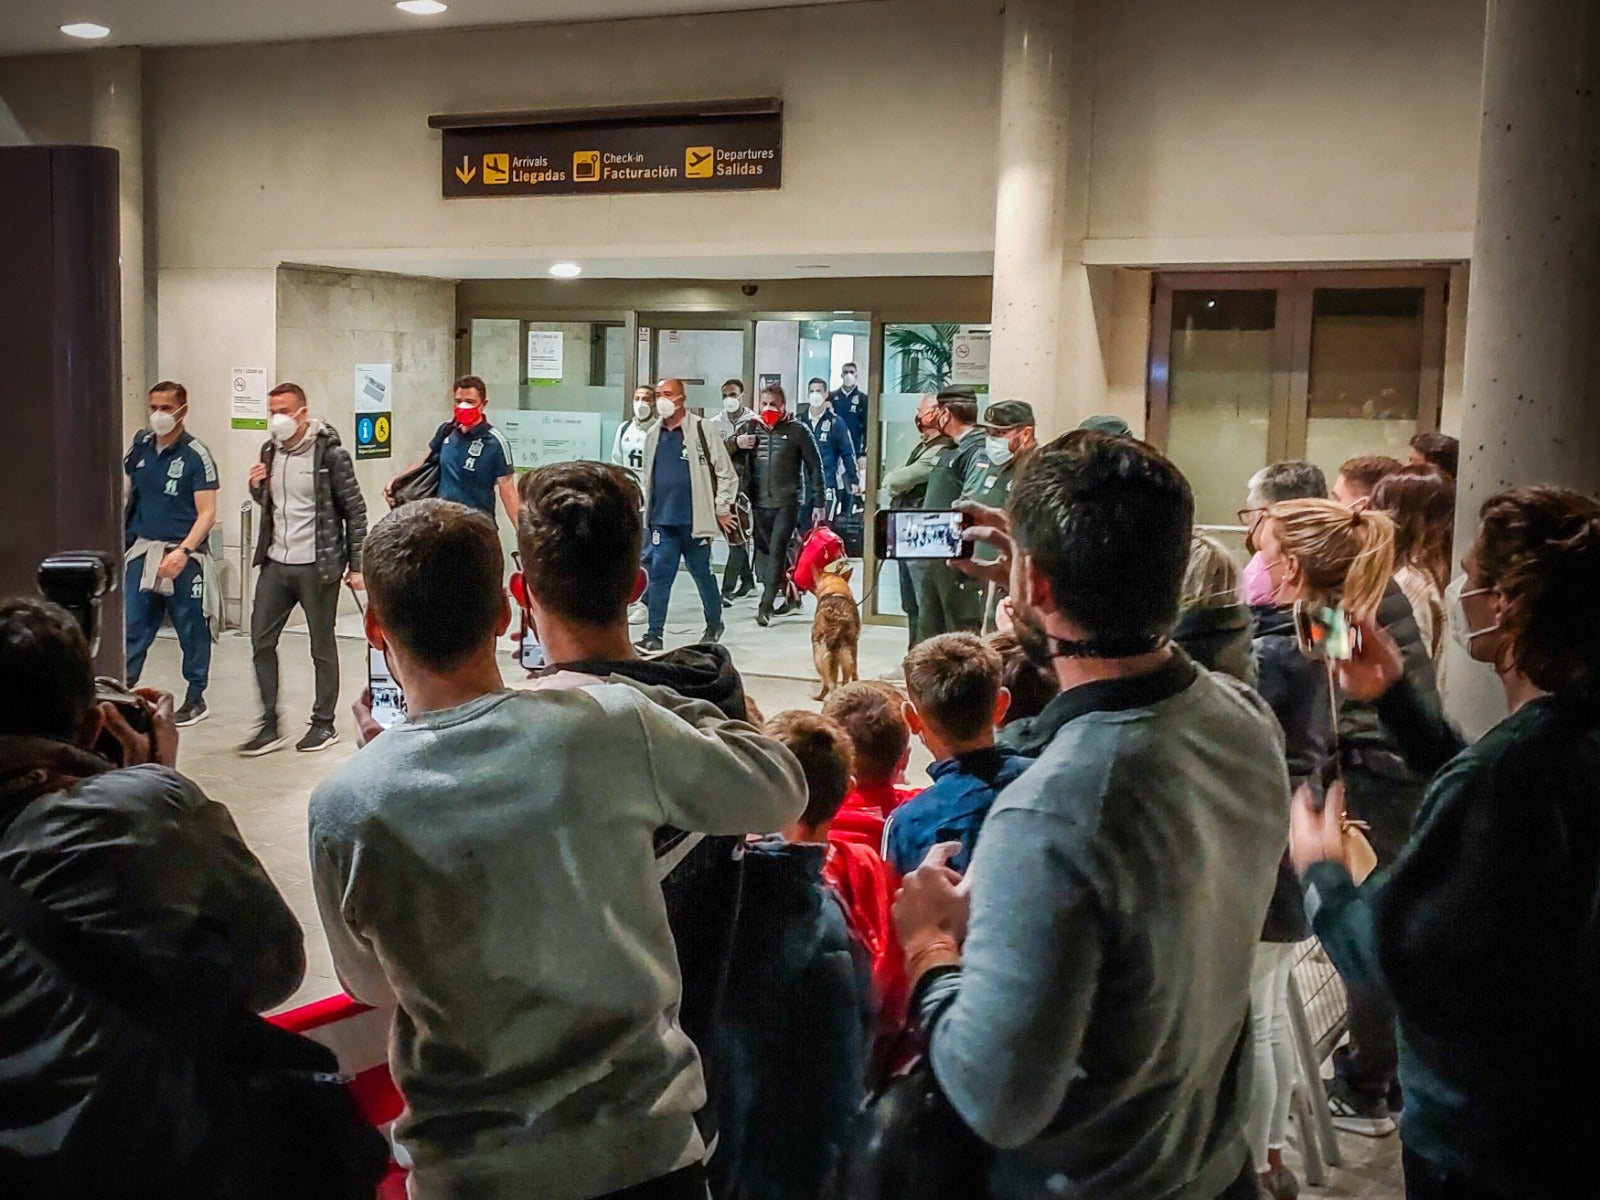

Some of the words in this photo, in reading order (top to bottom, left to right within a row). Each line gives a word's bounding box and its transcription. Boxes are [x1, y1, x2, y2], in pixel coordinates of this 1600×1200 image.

[512, 155, 548, 168] Arrivals
[603, 152, 644, 164] Check-in
[716, 148, 774, 162] Departures
[603, 165, 677, 180] Facturación
[716, 162, 763, 176] Salidas
[512, 169, 566, 185] Llegadas
